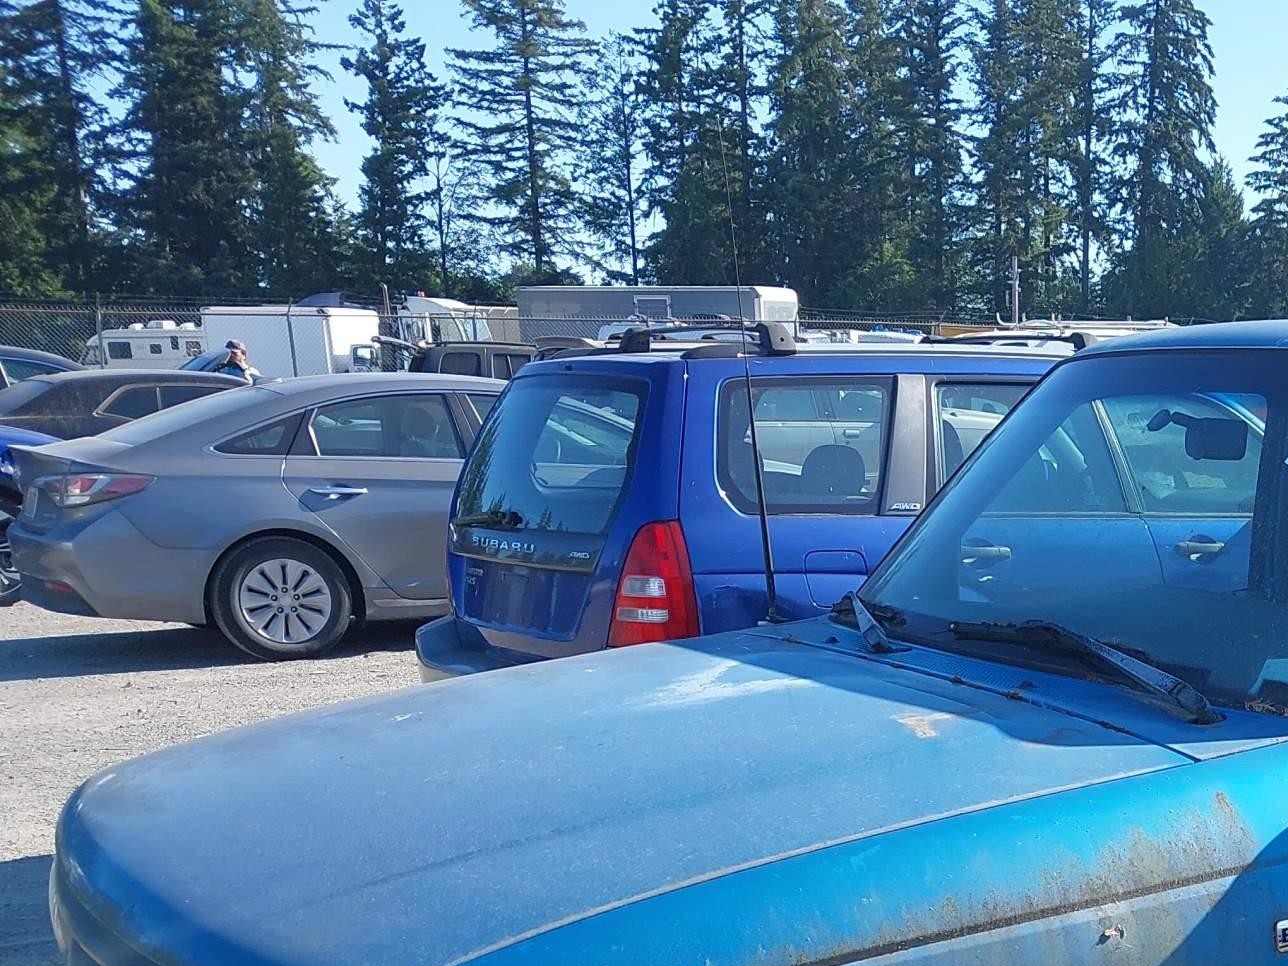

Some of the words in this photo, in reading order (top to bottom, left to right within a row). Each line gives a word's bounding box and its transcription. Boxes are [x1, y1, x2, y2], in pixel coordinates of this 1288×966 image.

[890, 502, 921, 510] AWD
[472, 536, 535, 553] SUBARU
[568, 551, 590, 559] AWD
